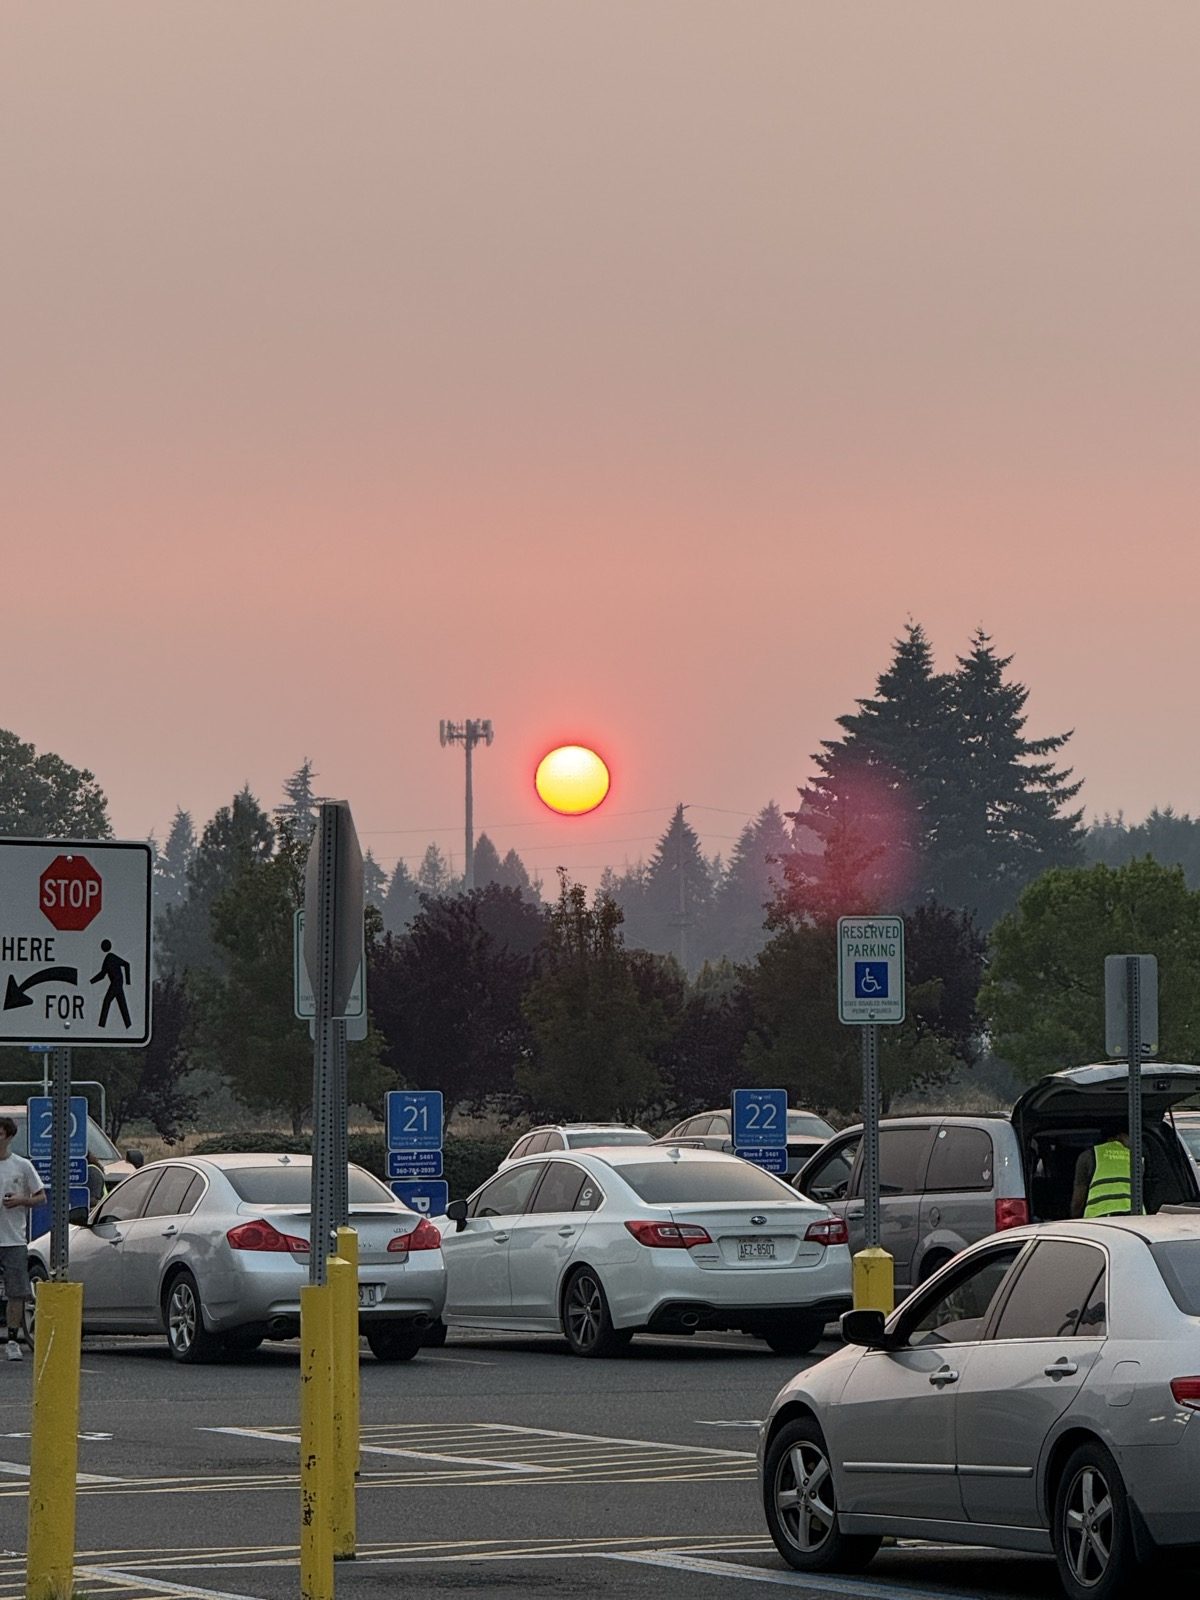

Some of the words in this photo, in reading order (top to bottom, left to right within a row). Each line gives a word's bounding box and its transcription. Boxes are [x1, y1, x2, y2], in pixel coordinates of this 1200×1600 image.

[43, 879, 100, 908] STOP
[843, 925, 899, 939] RESERVED
[2, 936, 56, 962] HERE
[847, 943, 896, 957] PARKING
[45, 995, 85, 1019] FOR
[403, 1105, 428, 1132] 21
[745, 1103, 777, 1129] 22
[583, 1188, 593, 1200] G
